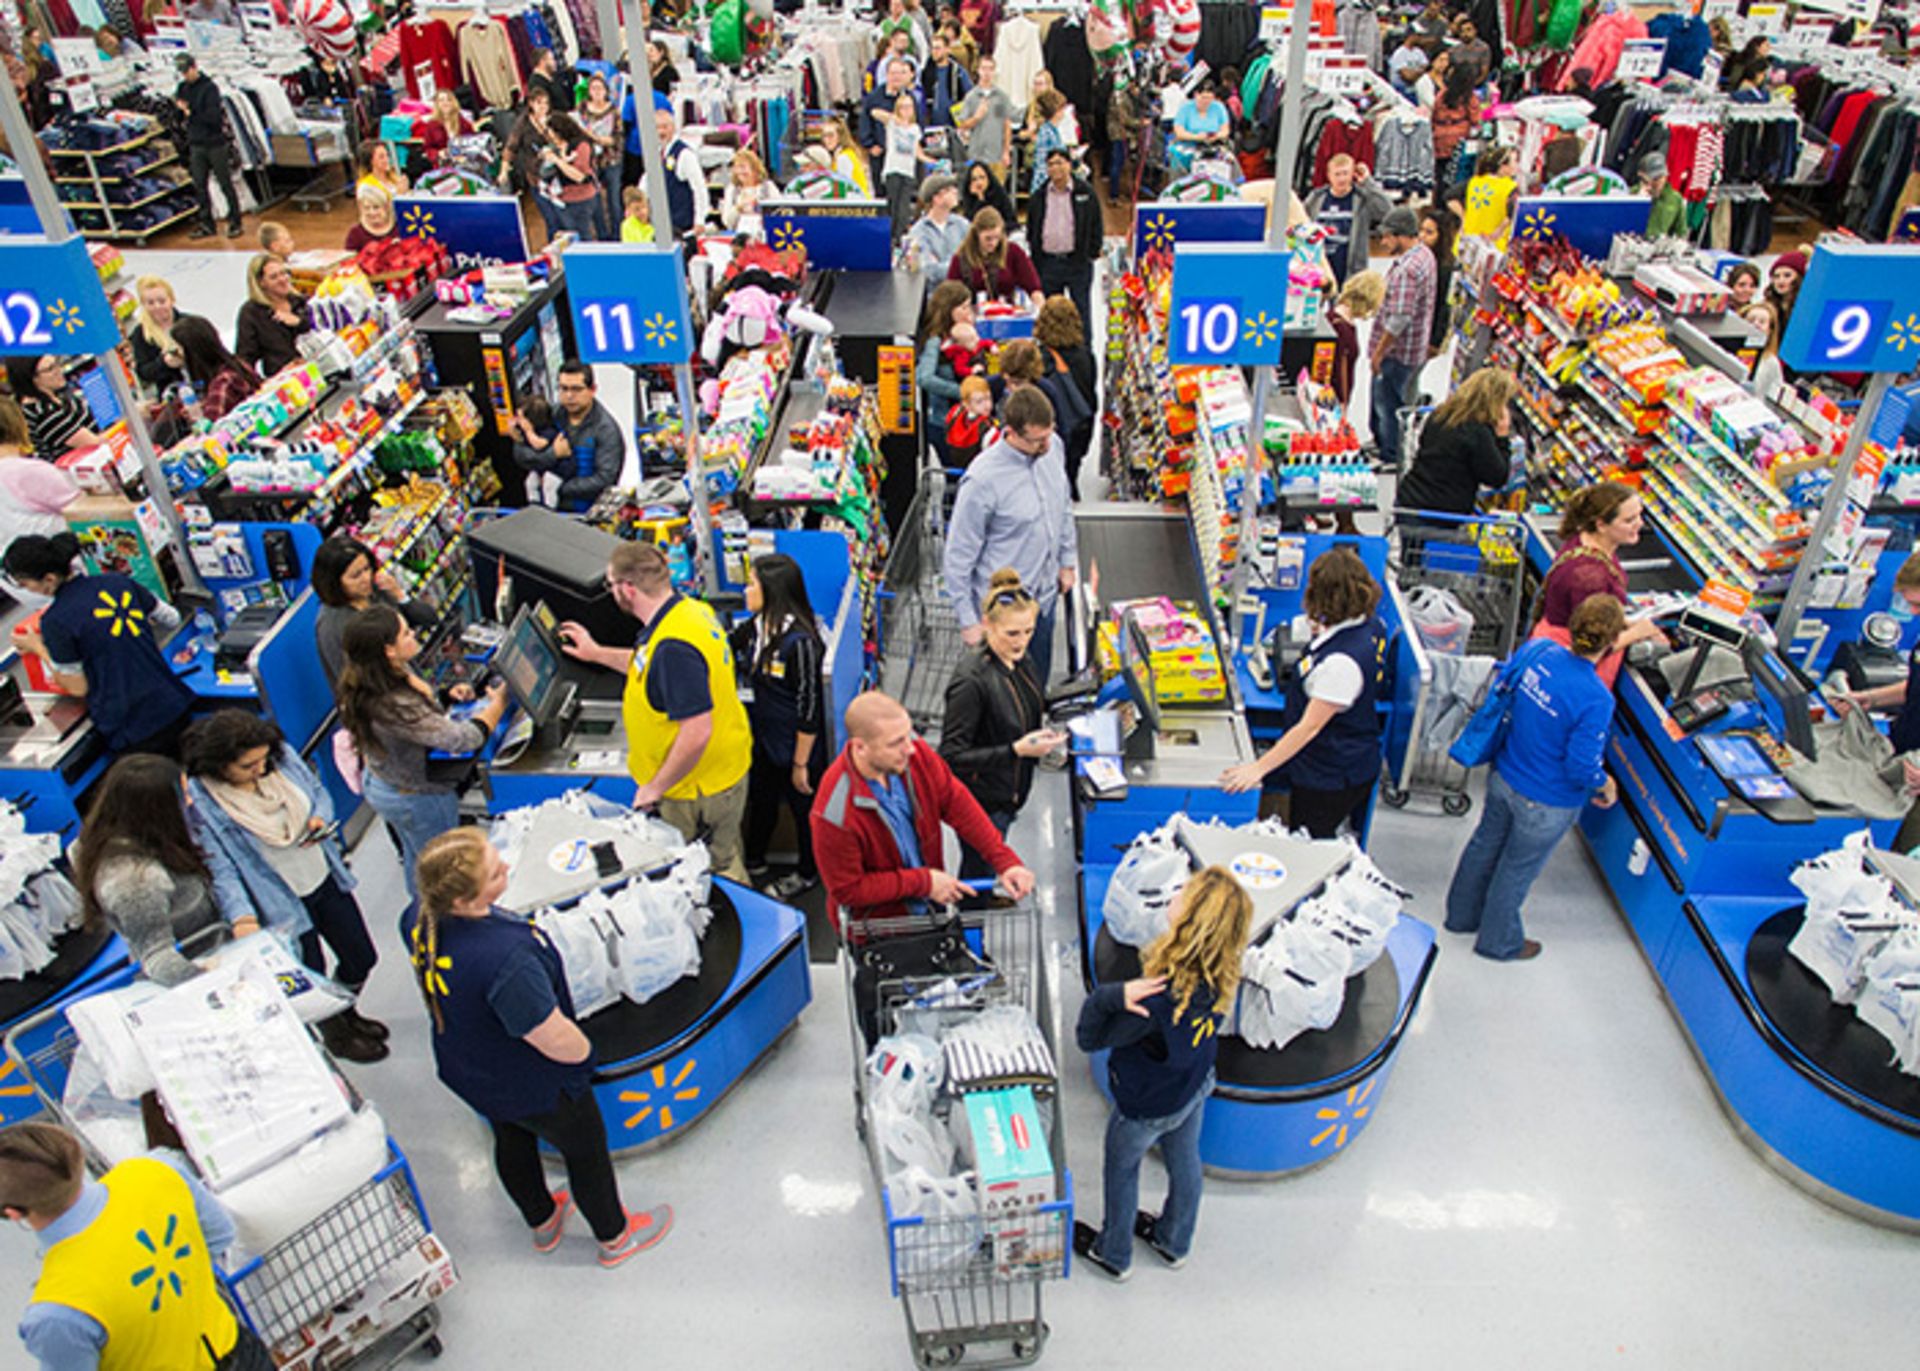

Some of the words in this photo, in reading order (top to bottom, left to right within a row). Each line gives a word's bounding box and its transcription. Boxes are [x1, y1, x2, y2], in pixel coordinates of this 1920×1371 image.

[582, 303, 634, 352] 11
[1181, 303, 1238, 353] 10
[1826, 305, 1871, 359] 9
